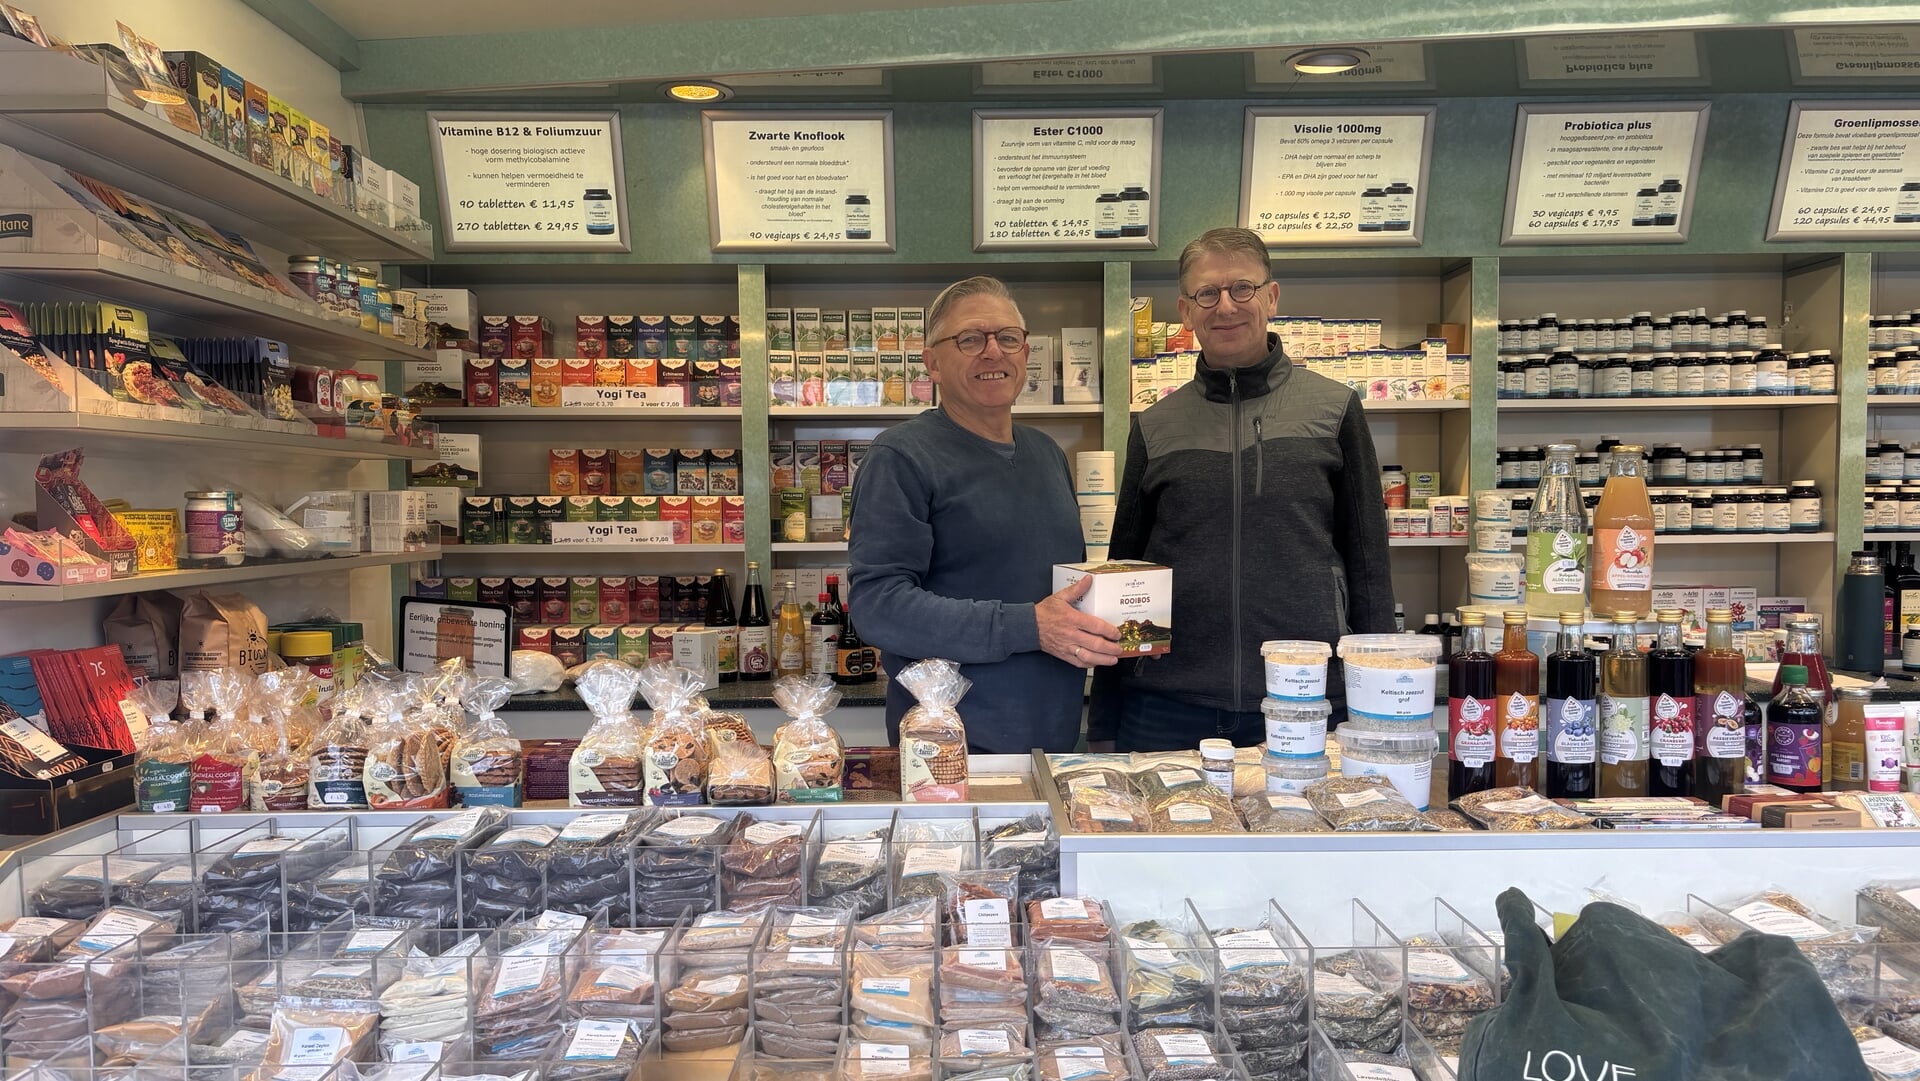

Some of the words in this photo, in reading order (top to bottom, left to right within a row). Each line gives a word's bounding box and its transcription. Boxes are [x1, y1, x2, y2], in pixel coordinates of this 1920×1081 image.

[1294, 125, 1332, 133] Visolie
[1337, 125, 1381, 134] 1000mg
[1565, 122, 1623, 130] Probiotica
[1628, 121, 1651, 131] plus
[440, 127, 493, 136] Vitamine
[497, 127, 519, 136] B12
[524, 127, 532, 136] &
[536, 127, 601, 136] Foliumzuur
[749, 131, 790, 140] Zwarte
[794, 131, 845, 140] Knoflook
[1034, 127, 1063, 136] Ester
[1067, 126, 1103, 135] C1000
[479, 199, 525, 208] tabletten
[530, 200, 537, 208] €
[543, 200, 575, 209] 11,95
[1549, 209, 1584, 219] vegicaps
[1598, 209, 1619, 217] 9,95
[1814, 206, 1848, 215] capsules
[1275, 212, 1309, 221] capsules
[1323, 212, 1351, 220] 12,50
[1815, 216, 1849, 225] capsules
[457, 222, 479, 231] 270
[484, 222, 530, 231] tabletten
[535, 222, 542, 231] €
[547, 222, 578, 231] 29,95
[1010, 219, 1048, 227] tabletten
[1063, 219, 1089, 227] 14,95
[1278, 222, 1311, 231] capsules
[1325, 222, 1353, 230] 22,50
[1544, 220, 1578, 229] capsules
[1593, 220, 1620, 228] 17,95
[765, 231, 800, 241] vegicaps
[814, 232, 841, 240] 24,95
[1012, 229, 1050, 237] tabletten
[597, 390, 622, 400] Yogi
[626, 390, 646, 398] Tea
[588, 526, 613, 536] Yogi
[1120, 597, 1150, 605] ROOIBOS
[410, 613, 436, 623] Eerlijke,
[438, 617, 478, 626] onbewerkte
[480, 621, 504, 632] honing
